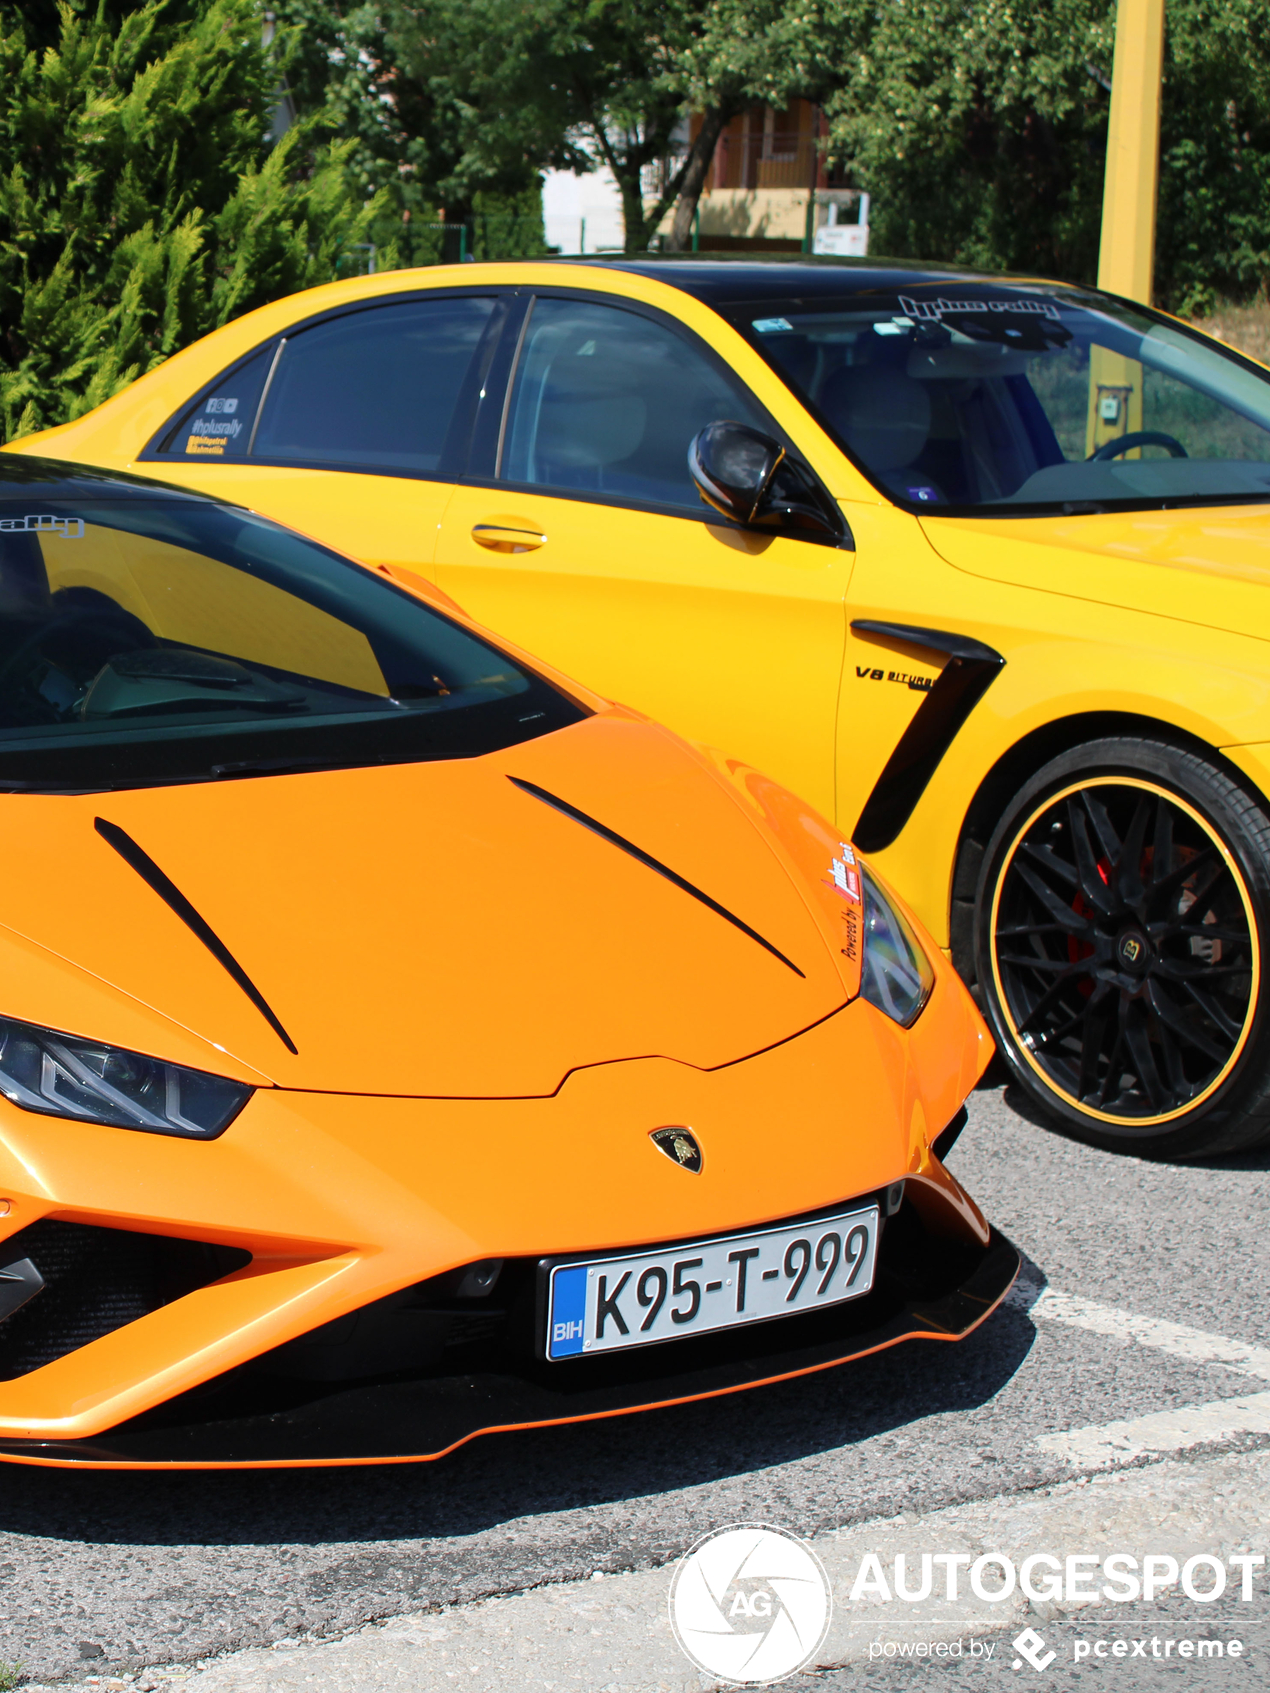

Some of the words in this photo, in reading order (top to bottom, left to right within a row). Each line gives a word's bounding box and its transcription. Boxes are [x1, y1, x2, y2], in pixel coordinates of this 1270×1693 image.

[856, 666, 884, 681] V8
[841, 849, 856, 866] Euro
[841, 907, 861, 919] by
[841, 916, 857, 962] Powered
[553, 1319, 583, 1342] BIH
[595, 1224, 869, 1339] K95-T-999
